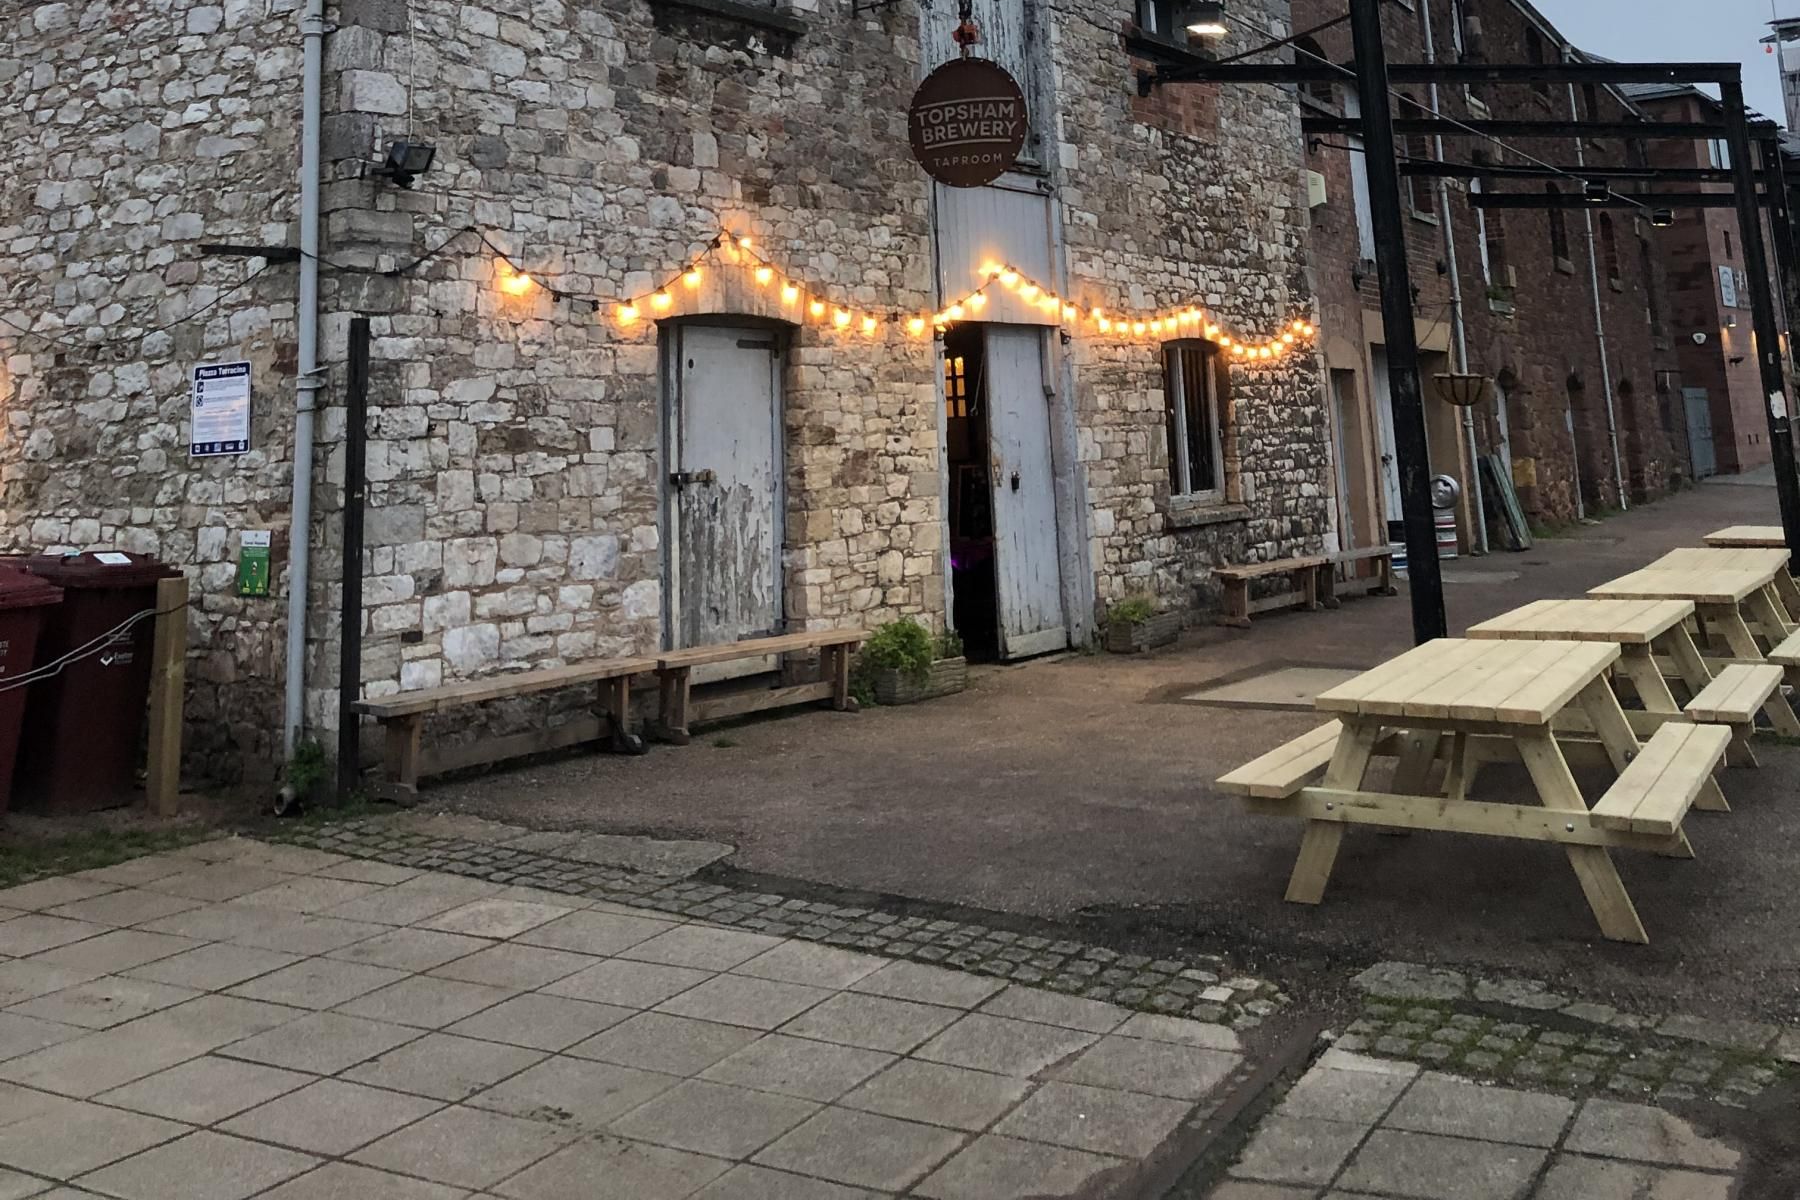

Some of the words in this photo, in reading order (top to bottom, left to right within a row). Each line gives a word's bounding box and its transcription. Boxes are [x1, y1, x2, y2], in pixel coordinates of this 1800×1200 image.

[916, 103, 1014, 127] TOPSHAM
[922, 121, 1017, 144] BREWERY
[934, 153, 1002, 167] TAPROOM
